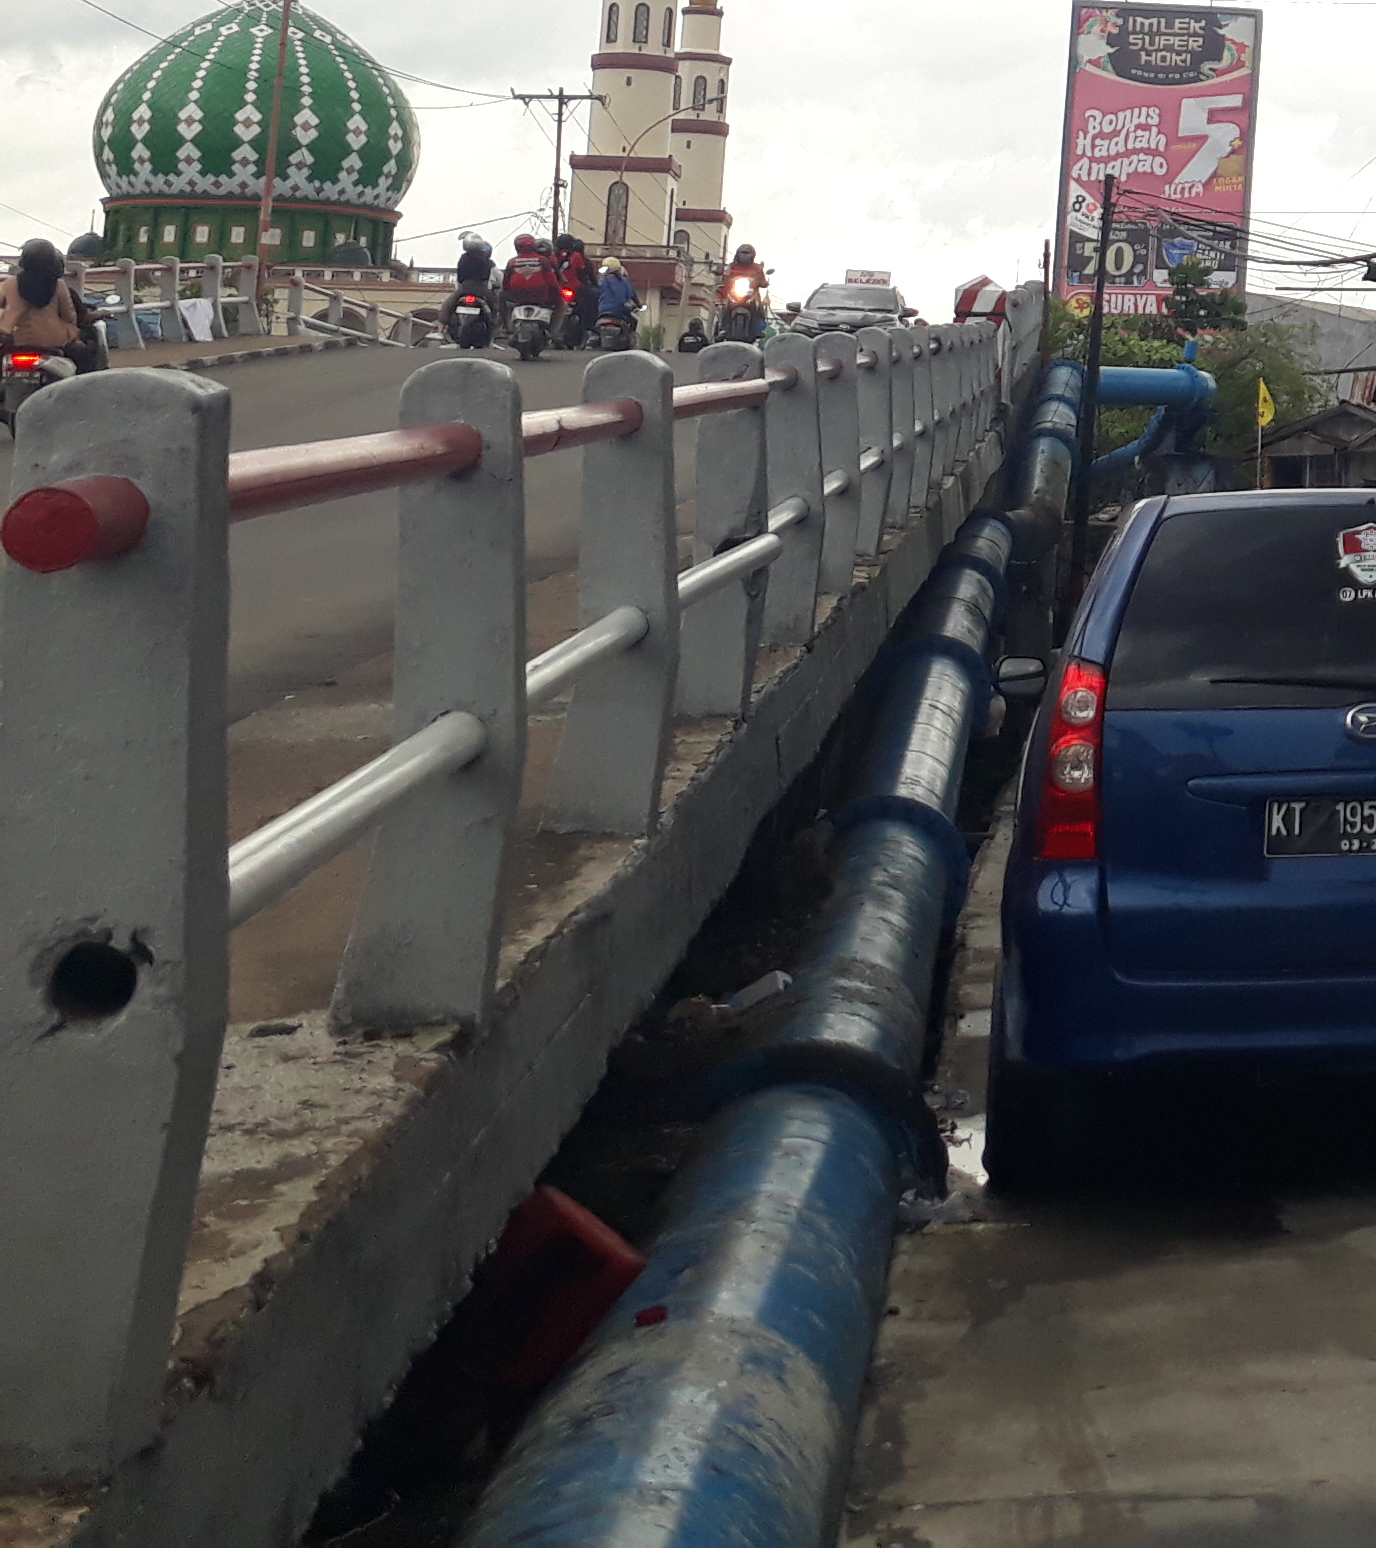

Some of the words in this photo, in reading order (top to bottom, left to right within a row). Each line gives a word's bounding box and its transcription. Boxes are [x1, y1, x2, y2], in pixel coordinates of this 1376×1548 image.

[1127, 16, 1206, 34] IMLEK
[1128, 33, 1203, 51] SUPER
[1140, 50, 1192, 67] HOKI
[1084, 105, 1160, 135] Bonus
[1075, 125, 1168, 157] Hadiah
[1178, 93, 1243, 183] 5
[1071, 152, 1169, 182] Angpao
[1160, 181, 1205, 200] JUTA
[1072, 194, 1086, 213] 8
[1103, 293, 1159, 315] SURYA
[1358, 588, 1373, 599] LPK
[1271, 802, 1307, 836] KT
